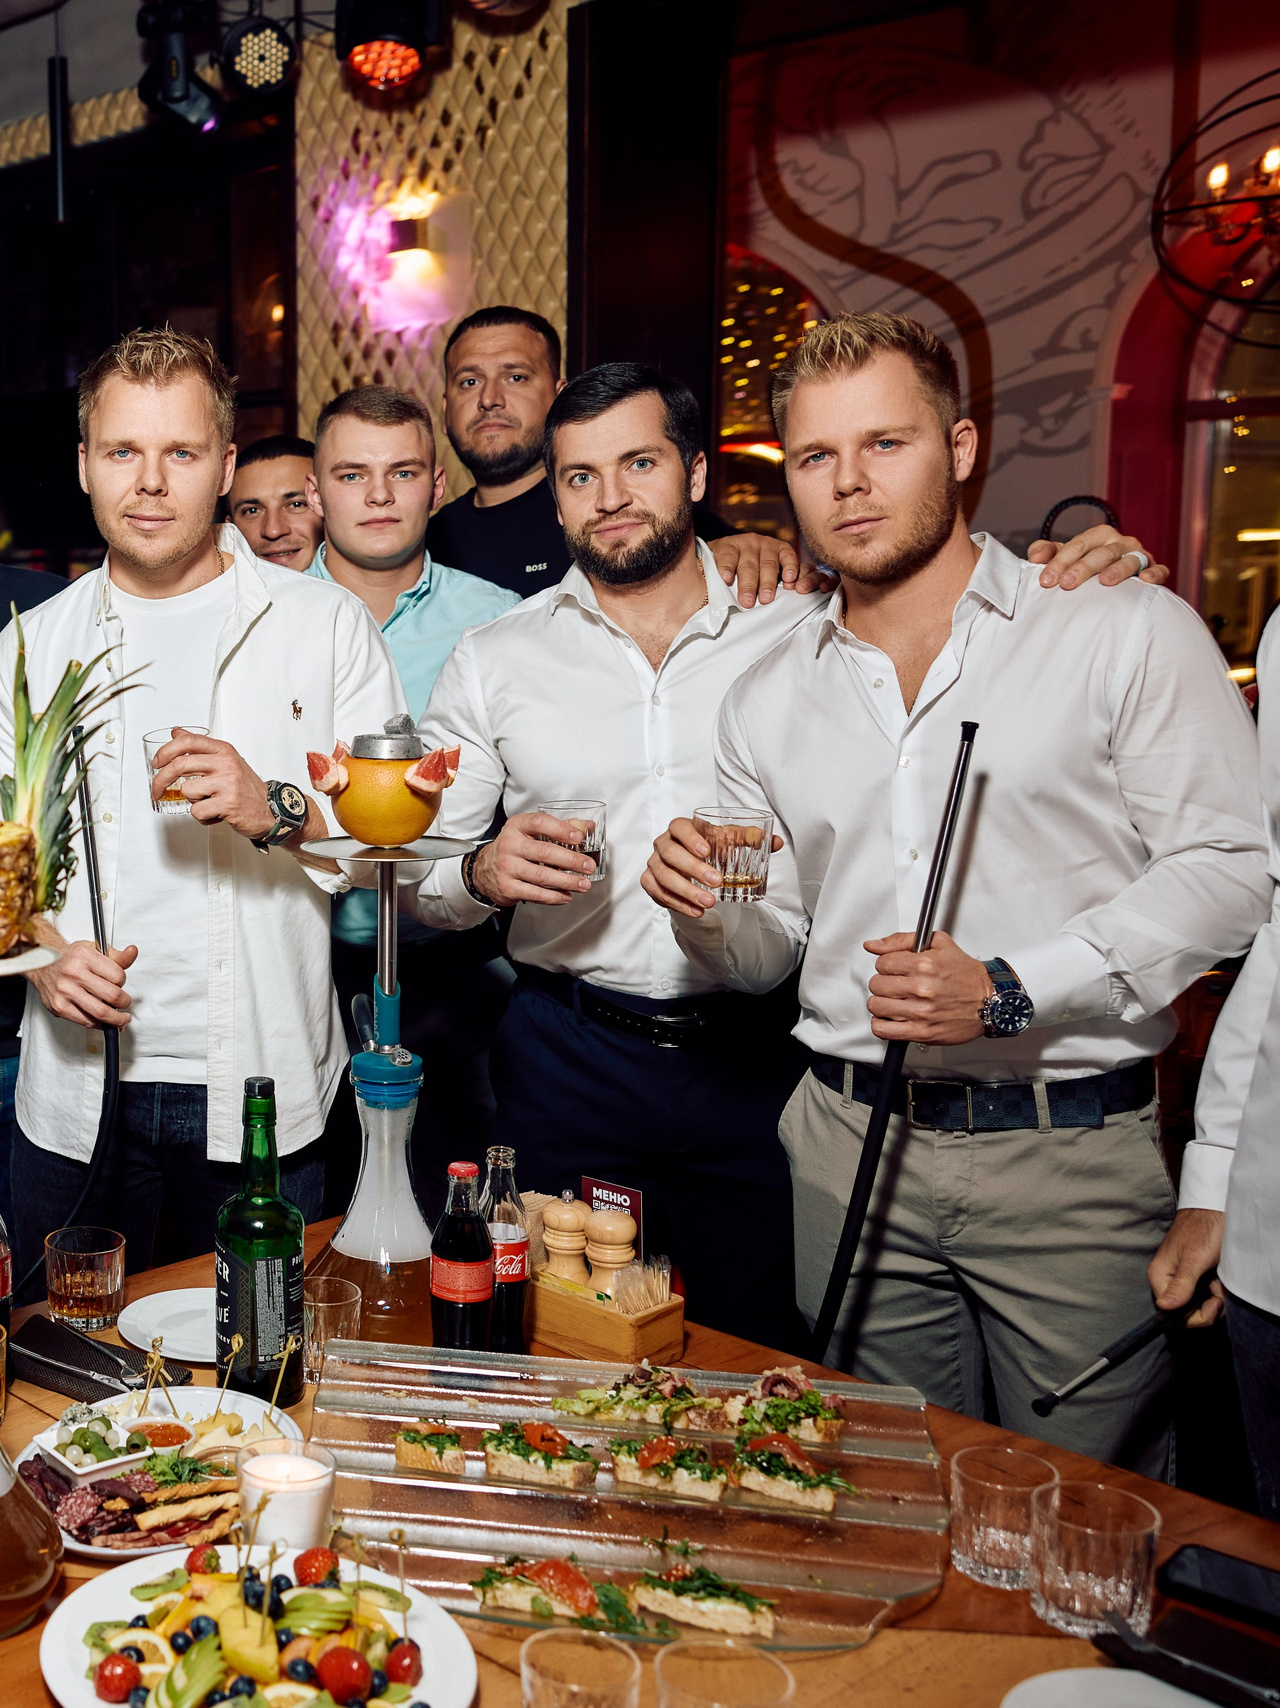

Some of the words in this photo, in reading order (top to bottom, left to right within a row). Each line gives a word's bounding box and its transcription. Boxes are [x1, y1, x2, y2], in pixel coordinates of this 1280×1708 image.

[525, 562, 548, 573] BOSS
[592, 1186, 631, 1207] МЕНЮ
[494, 1254, 524, 1275] Cola
